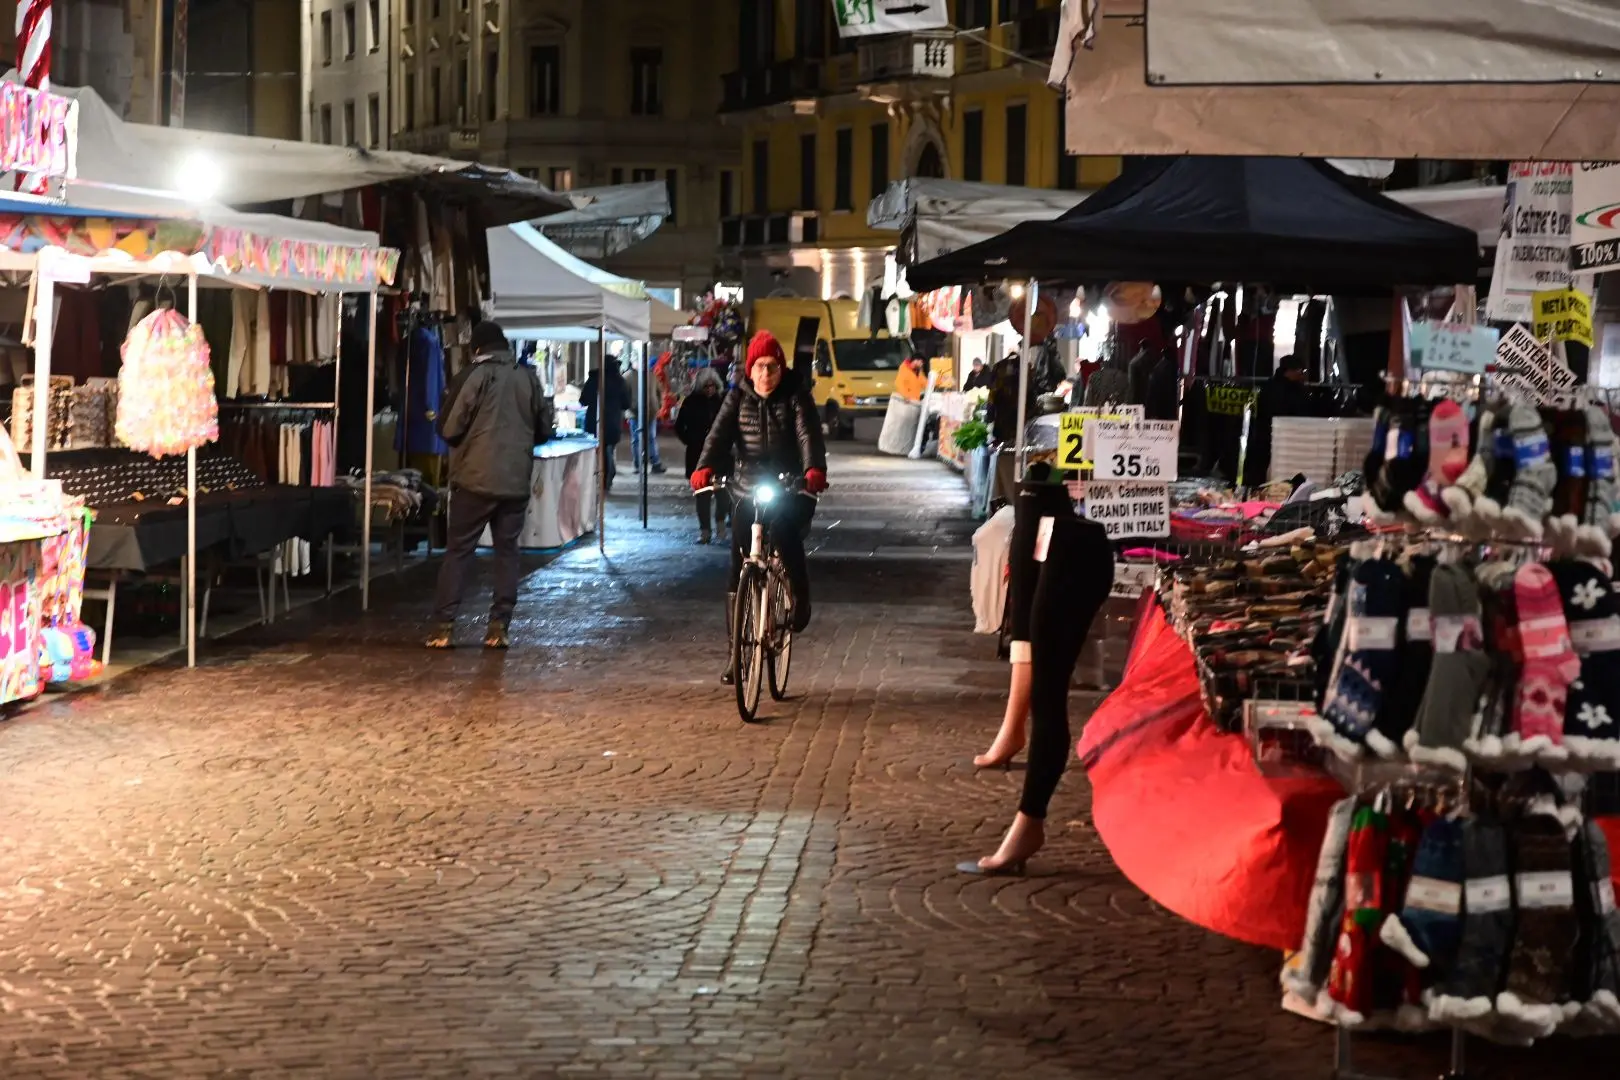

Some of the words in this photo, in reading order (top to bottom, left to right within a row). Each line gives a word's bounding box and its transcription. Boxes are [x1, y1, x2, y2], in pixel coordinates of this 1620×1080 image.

[1580, 242, 1614, 266] 100%
[1088, 485, 1113, 500] 100%
[1118, 484, 1164, 498] Cashmere
[1090, 503, 1130, 518] GRANDI
[1132, 501, 1164, 516] FIRME
[1123, 521, 1133, 533] IN
[1137, 520, 1165, 532] ITALY
